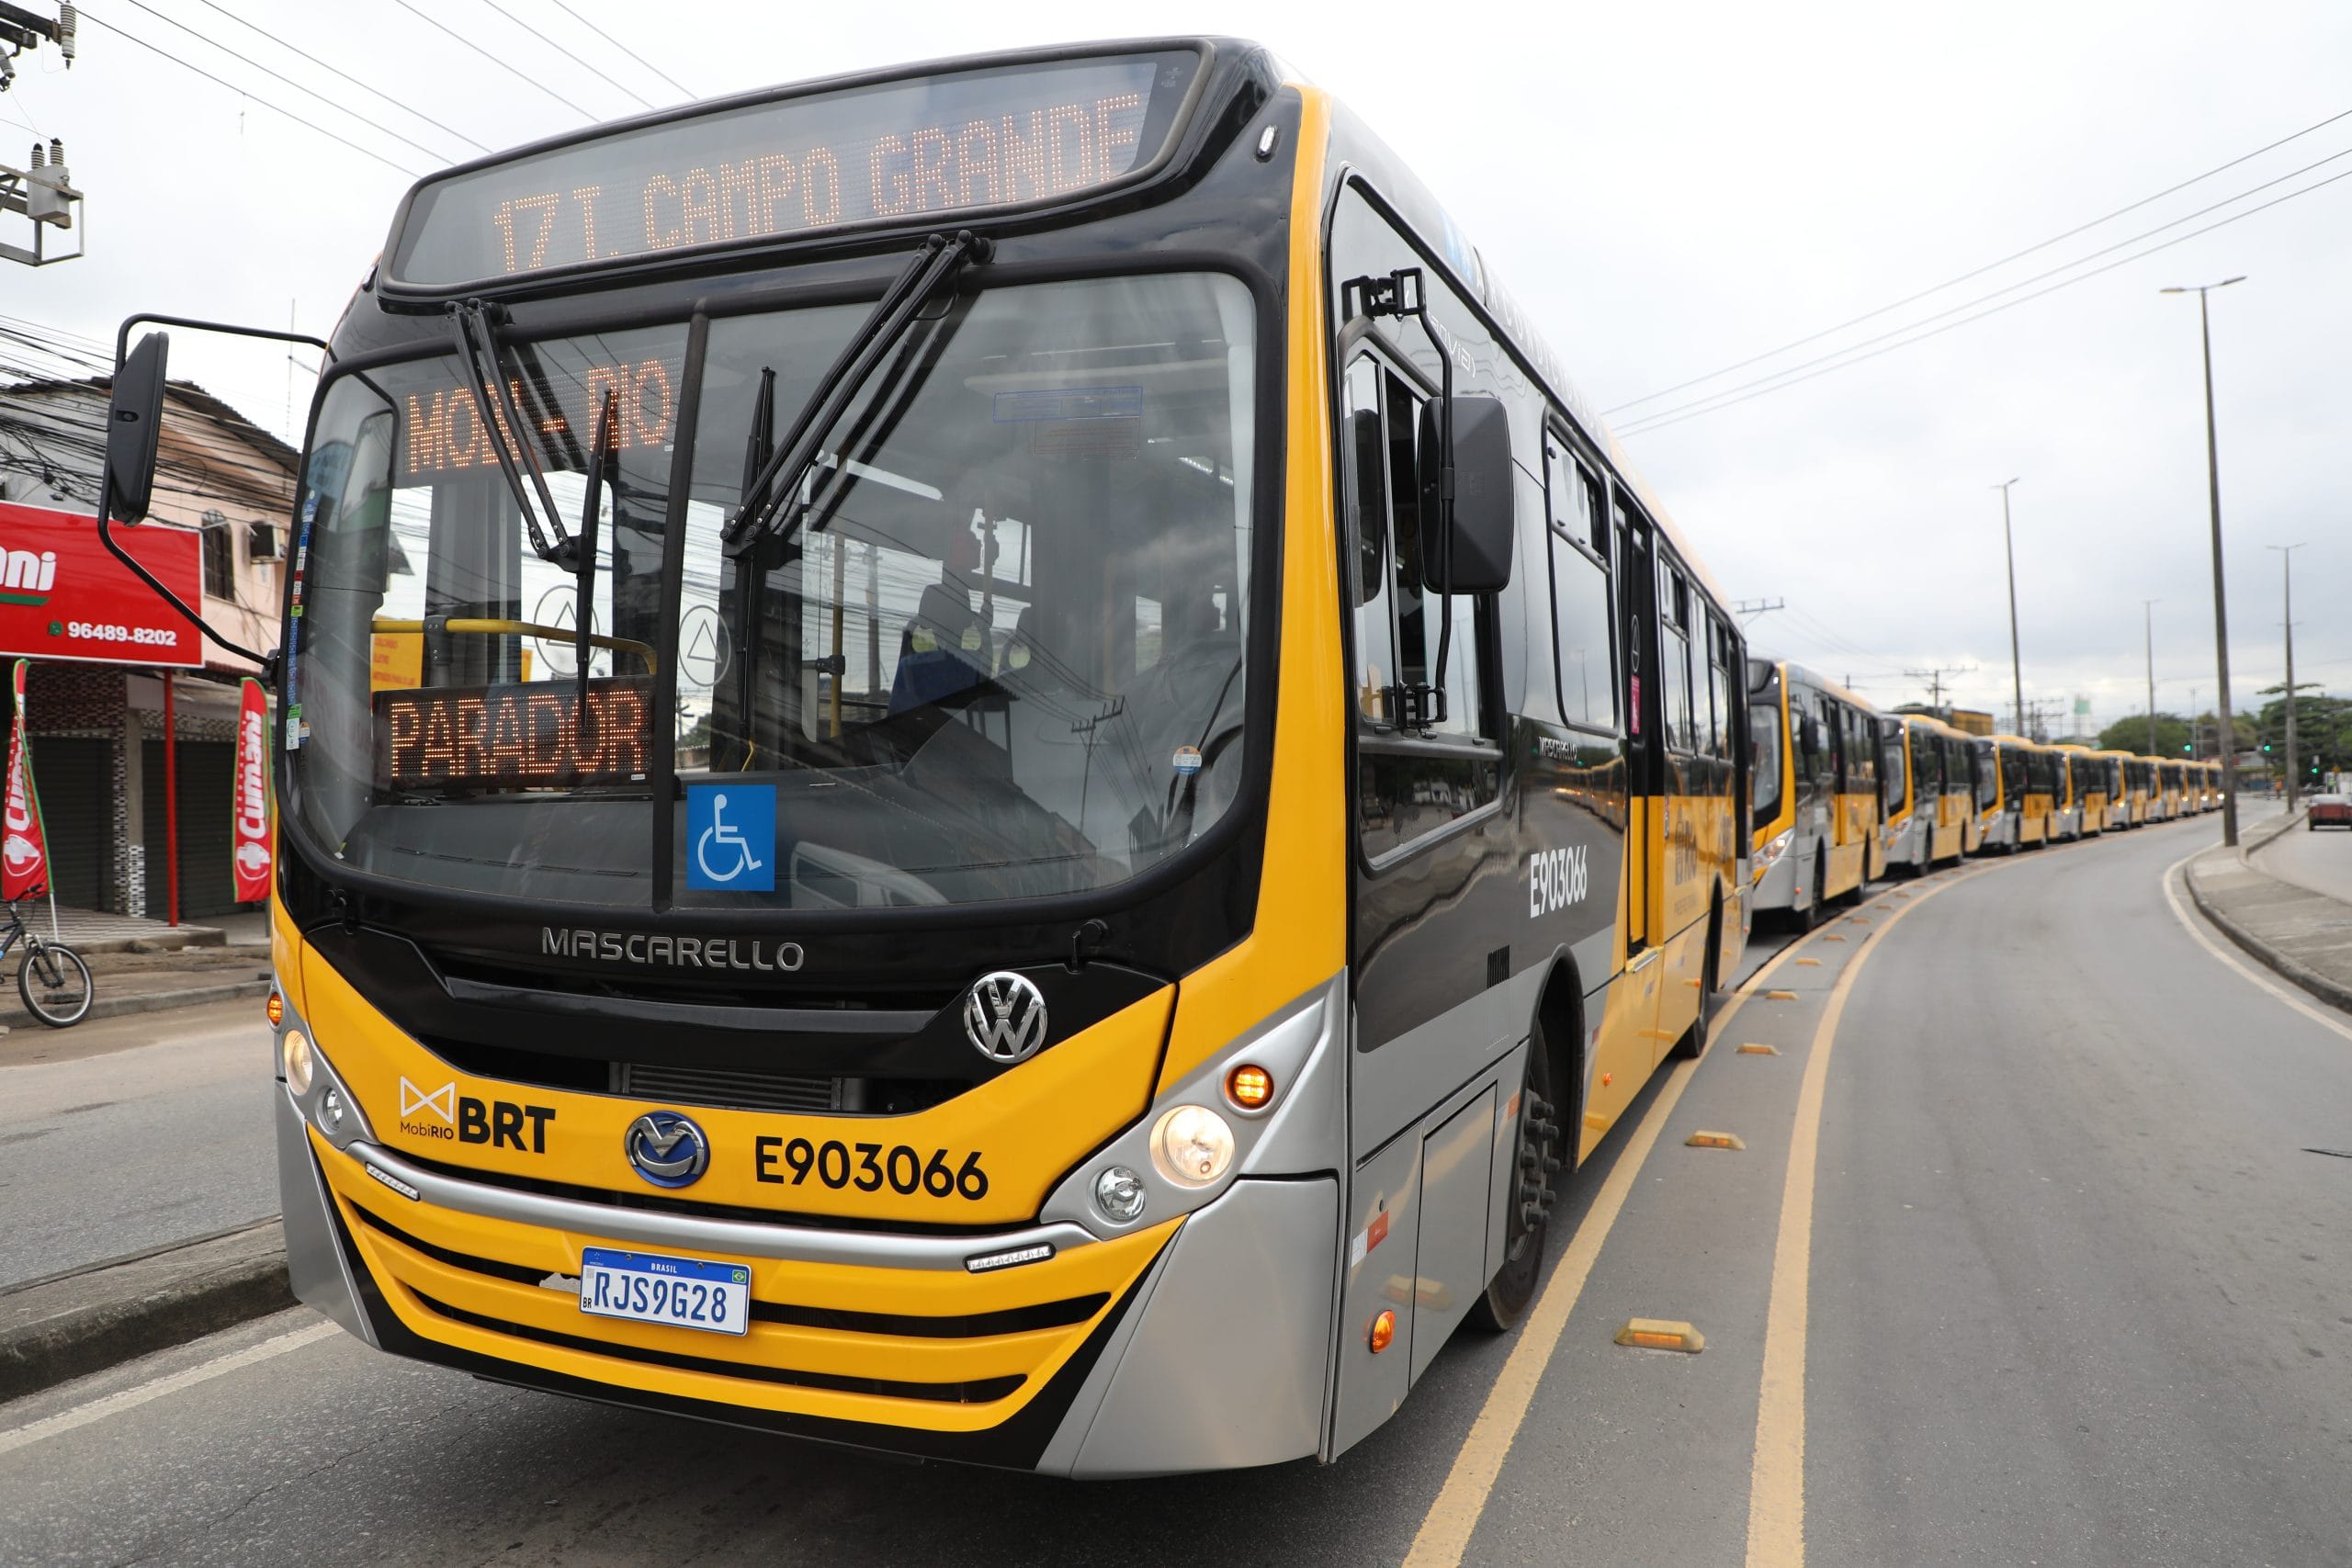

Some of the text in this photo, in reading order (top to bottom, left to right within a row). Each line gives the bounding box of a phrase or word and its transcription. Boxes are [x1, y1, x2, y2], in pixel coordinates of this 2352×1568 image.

[492, 193, 559, 272] 17
[643, 146, 840, 250] CAMPO
[588, 359, 670, 451] RIO
[0, 546, 57, 592] ni
[67, 621, 177, 647] 96489-8202
[390, 689, 642, 778] PARADOR
[238, 710, 266, 840] Cumani
[1530, 844, 1588, 919] E903066
[541, 926, 805, 972] MASCARELLO
[400, 1096, 557, 1155] MobiRIO BRT
[754, 1134, 989, 1201] E903066
[582, 1271, 728, 1324] BR RJS9G28
[650, 1262, 678, 1274] BRASIL
